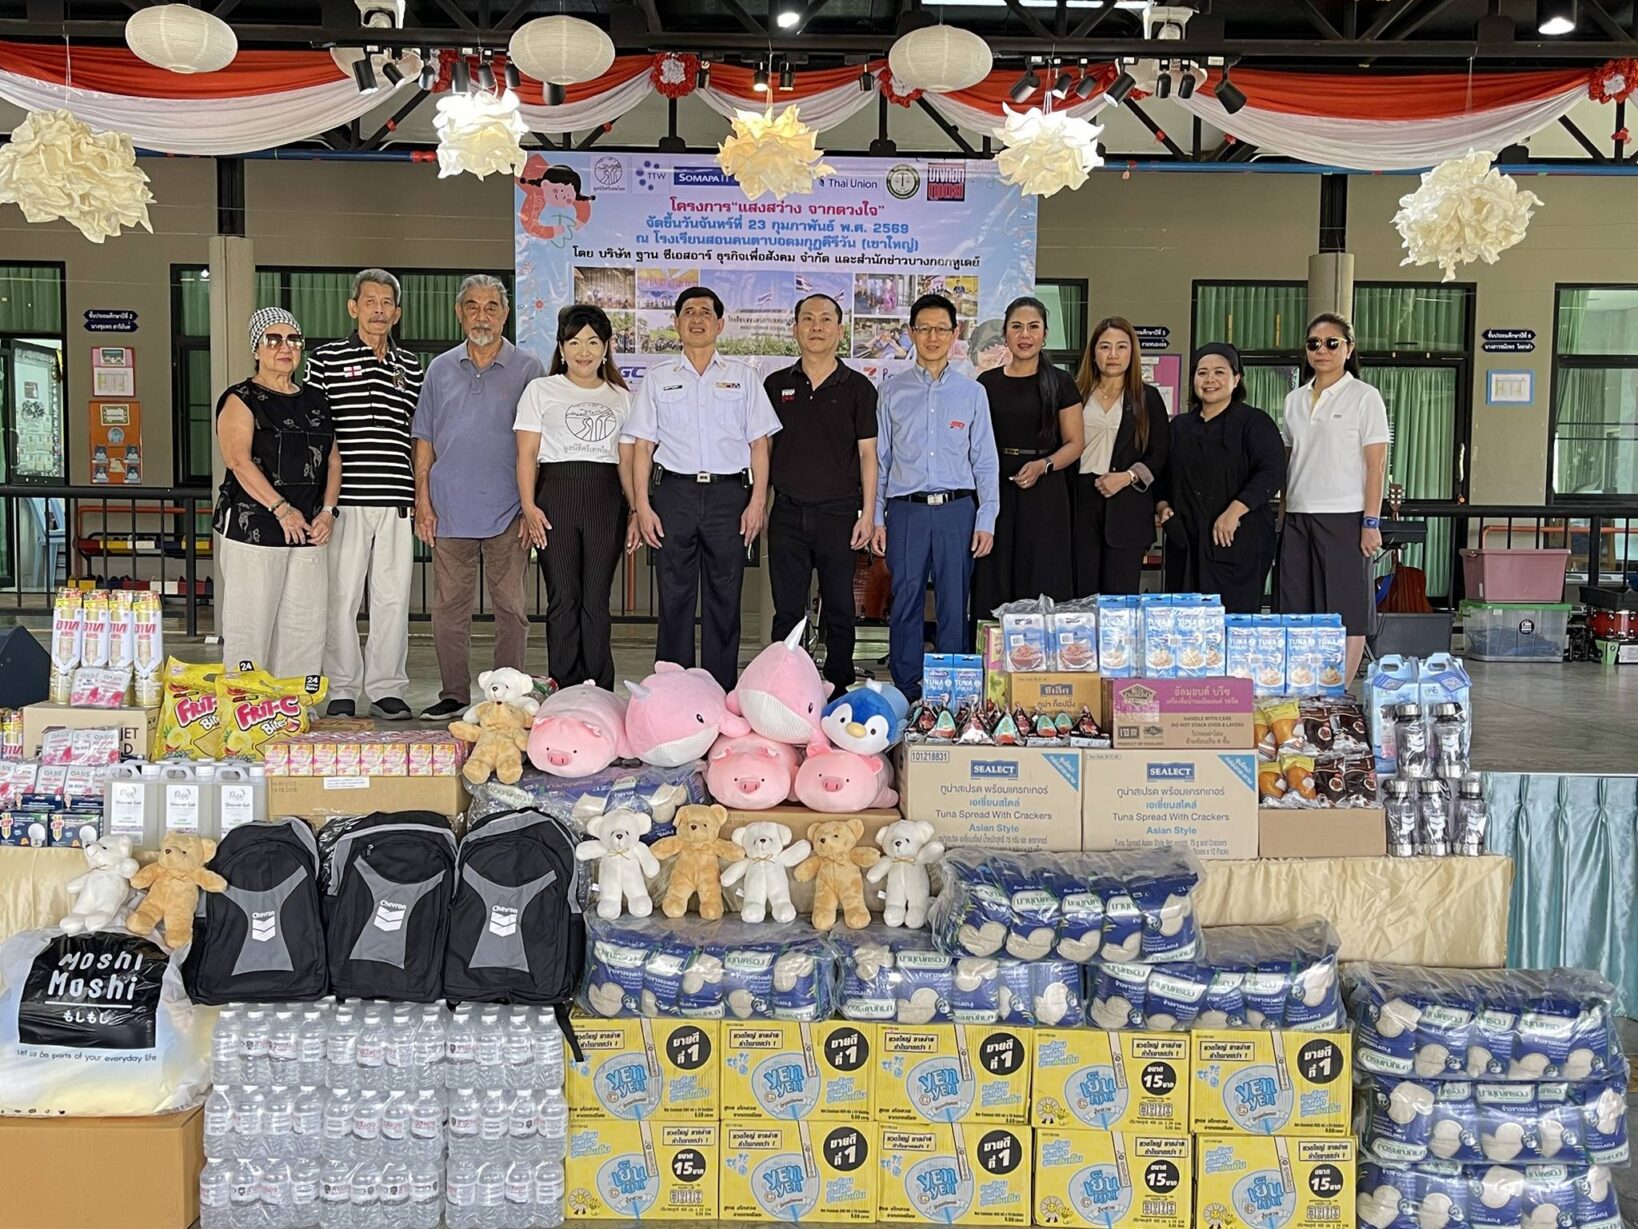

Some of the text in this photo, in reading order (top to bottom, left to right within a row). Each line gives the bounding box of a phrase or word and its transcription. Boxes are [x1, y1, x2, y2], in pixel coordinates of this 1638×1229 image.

[648, 172, 666, 180] TTW
[679, 174, 720, 182] SOMAPA
[828, 178, 878, 188] Thai Union
[646, 212, 910, 235] จัดขึ้นวันจันทร์ที่ 23 กุมภาพันธ์ พ.ศ. 2569
[636, 234, 648, 244] ณ
[862, 236, 918, 253] (เขาใหญ่)
[573, 246, 594, 258] โดย
[598, 247, 631, 259] บริษัท
[636, 249, 658, 262] ฐาน
[664, 248, 712, 260] ซีเอสอาร์
[716, 248, 795, 264] ธุรกิจเพื่อสังคม
[800, 252, 830, 264] จำกัด
[240, 662, 252, 670] 24
[306, 676, 320, 684] 24
[1174, 685, 1230, 696] อัลมอนด์ บรีซ
[974, 765, 1016, 774] SEALECT
[1150, 768, 1192, 776] SEALECT
[936, 810, 1052, 820] Tuna Spread With Crackers
[1113, 813, 1230, 823] Tuna Spread With Crackers
[969, 824, 1020, 834] Asian Style
[1146, 826, 1197, 836] Asian Style
[380, 900, 407, 911] Chevron
[492, 904, 518, 914] Chevron
[252, 910, 276, 920] Chevron
[48, 970, 138, 1000] Moshi
[674, 1032, 700, 1047] ขายดี
[832, 1034, 858, 1048] ขายดี
[986, 1038, 1014, 1053] ขายดี
[40, 1051, 50, 1059] be
[52, 1052, 72, 1062] parts
[74, 1052, 83, 1060] of
[84, 1055, 102, 1064] your
[104, 1054, 142, 1064] everyday
[144, 1054, 157, 1062] life
[687, 1044, 700, 1062] 1
[844, 1046, 857, 1064] 1
[990, 1050, 1013, 1070] ที่ 1
[830, 1132, 857, 1148] ขายดี
[834, 1146, 856, 1166] ที่ 1
